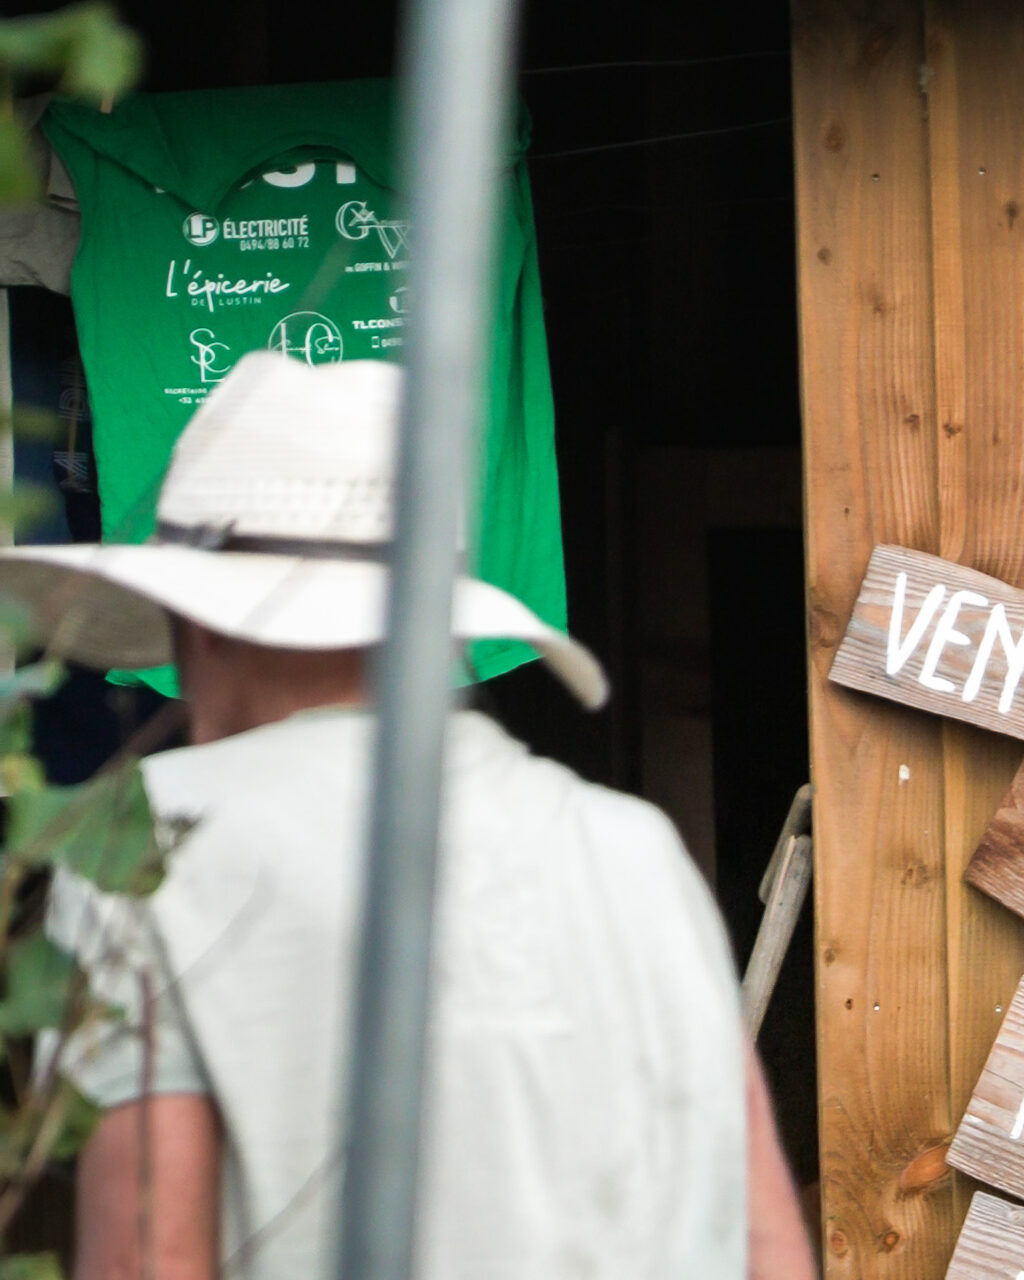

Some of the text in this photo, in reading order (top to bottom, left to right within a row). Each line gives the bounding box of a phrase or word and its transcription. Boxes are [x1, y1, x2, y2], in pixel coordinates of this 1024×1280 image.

[223, 213, 310, 240] ÉLECTRICITÉ
[298, 236, 310, 250] 72
[166, 259, 291, 313] L'épicerie
[219, 296, 263, 307] LUSTIN
[352, 317, 408, 330] TLCONS
